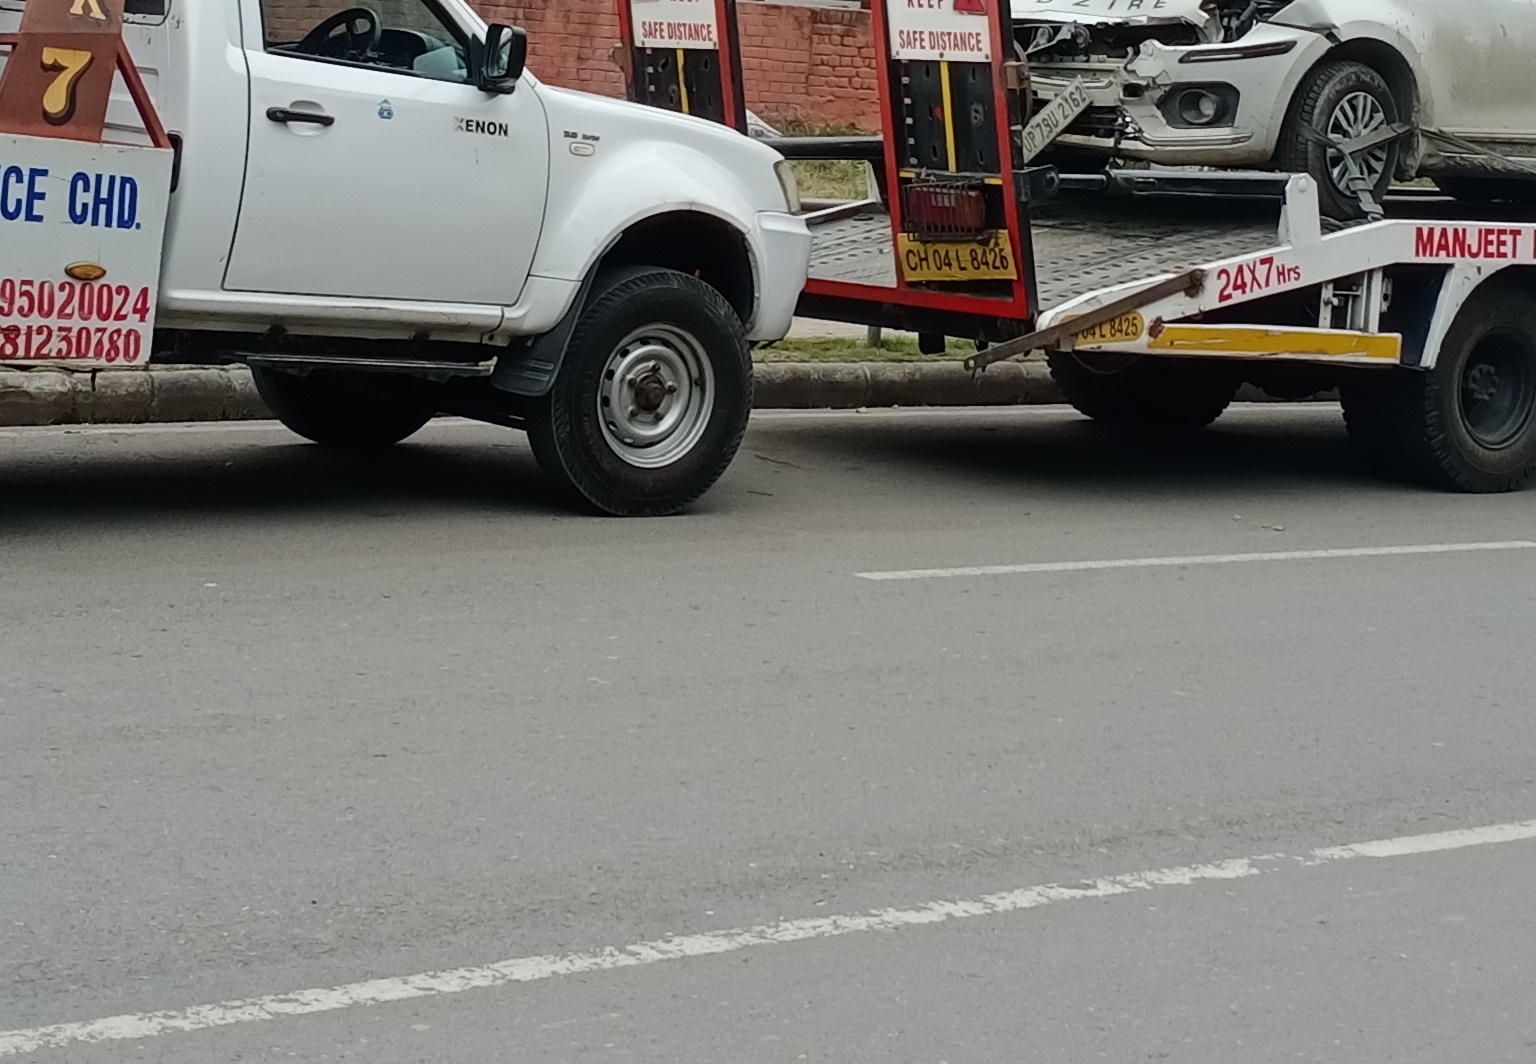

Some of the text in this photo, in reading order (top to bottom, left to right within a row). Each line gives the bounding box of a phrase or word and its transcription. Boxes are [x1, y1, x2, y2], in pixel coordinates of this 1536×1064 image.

[641, 21, 714, 42] SAFE DISTANCE
[898, 29, 983, 52] SAFE DISTANCE
[41, 46, 93, 117] 7
[453, 116, 509, 137] XENON
[68, 171, 142, 230] CHD.
[1414, 227, 1522, 259] MANJEET
[905, 248, 929, 272] CH
[933, 248, 953, 271] 04
[956, 248, 968, 271] L
[1276, 263, 1301, 286] Hrs
[1109, 316, 1138, 338] 8425
